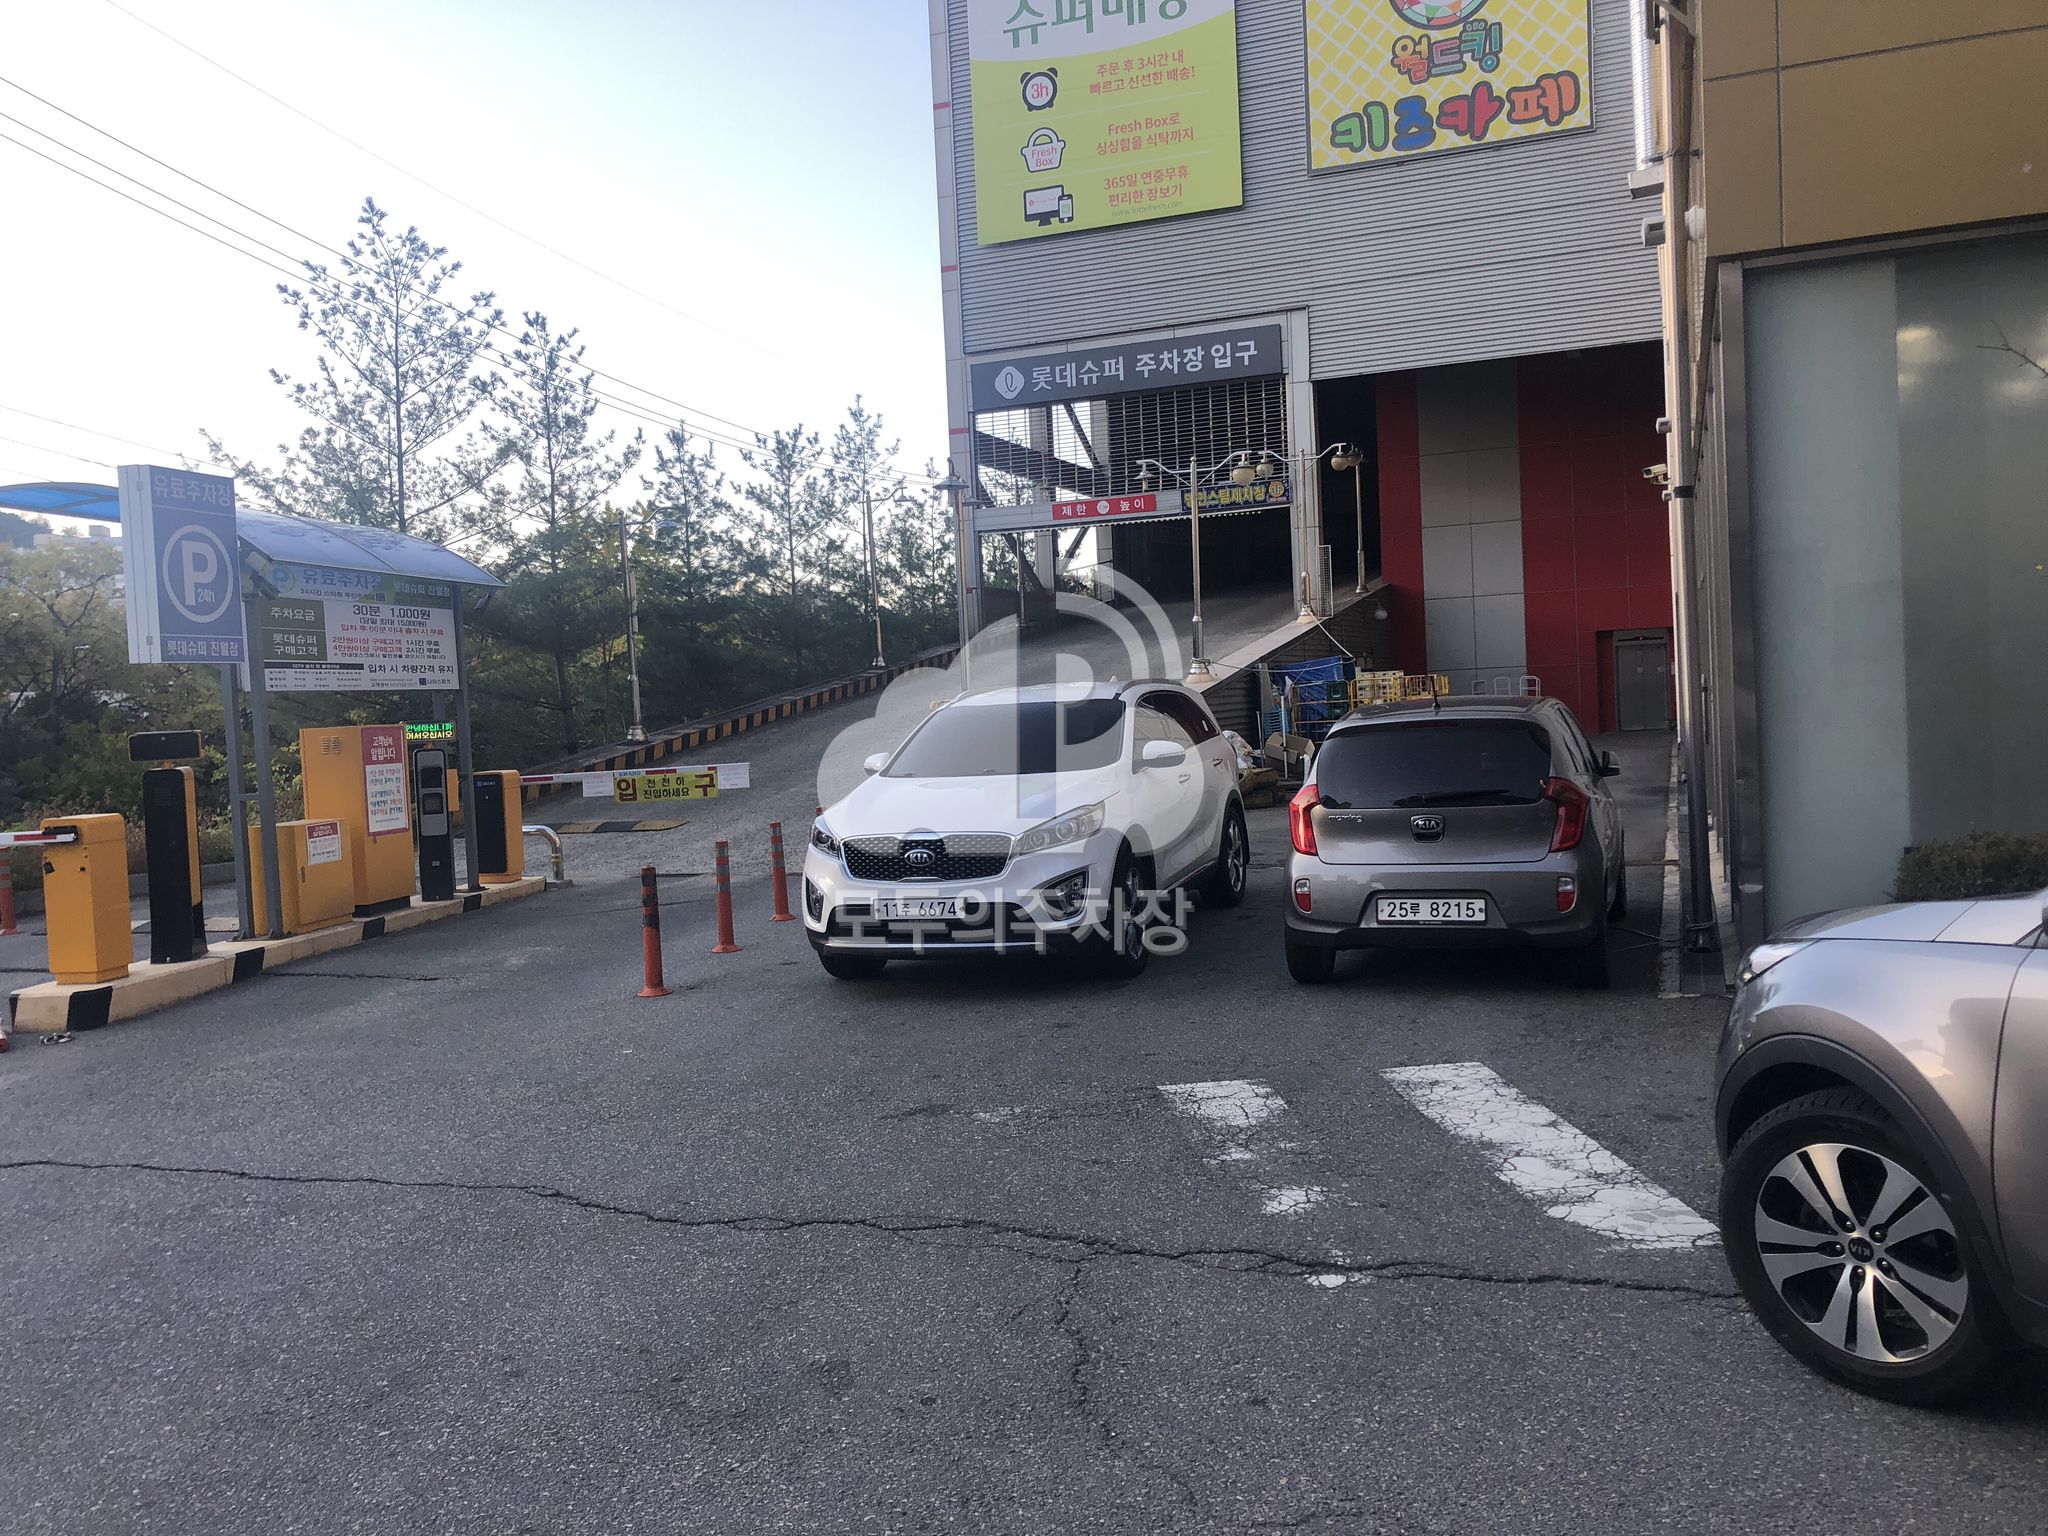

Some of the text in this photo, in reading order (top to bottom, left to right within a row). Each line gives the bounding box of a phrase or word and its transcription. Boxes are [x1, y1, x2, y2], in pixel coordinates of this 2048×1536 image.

[1392, 21, 1502, 84] 월드킹
[1097, 49, 1184, 78] 주문 후 3시간 내
[1089, 66, 1195, 95] 빠르고 신선한 배송!
[1031, 83, 1049, 99] 3h
[1331, 71, 1580, 152] 키즈카페
[1108, 112, 1180, 135] Fresh Box로
[1096, 126, 1194, 155] 싱싱함을 식탁까지
[1031, 146, 1057, 158] Fresh
[1035, 157, 1053, 167] Box
[1104, 165, 1188, 190] 365일 연중무휴
[1109, 183, 1182, 207] 편리한 장보기
[1031, 340, 1258, 392] 롯데슈퍼 주차장 입구
[153, 474, 232, 507] 유료주차장
[1062, 503, 1087, 516] 제한
[1120, 497, 1145, 511] 높이
[197, 588, 215, 603] 24h
[271, 606, 316, 621] 주차요금
[353, 604, 381, 617] 30분
[273, 633, 317, 645] 롯데슈퍼
[167, 640, 239, 657] 롯데슈퍼 진월점
[273, 645, 318, 656] 구매고객
[368, 664, 386, 673] 입차
[390, 664, 398, 673] 시
[401, 664, 435, 674] 차량간격
[438, 665, 454, 674] 유지
[405, 722, 453, 732] 안녕하십니까
[405, 730, 453, 740] 어서오십시오
[371, 746, 396, 761] 알립니다
[616, 778, 637, 801] 입
[694, 773, 715, 797] 구
[643, 787, 690, 800] 진입하세요
[1418, 820, 1438, 829] KIA
[909, 852, 930, 863] KIA
[883, 901, 957, 917] 11주 6674
[1387, 902, 1476, 918] 25루 8215
